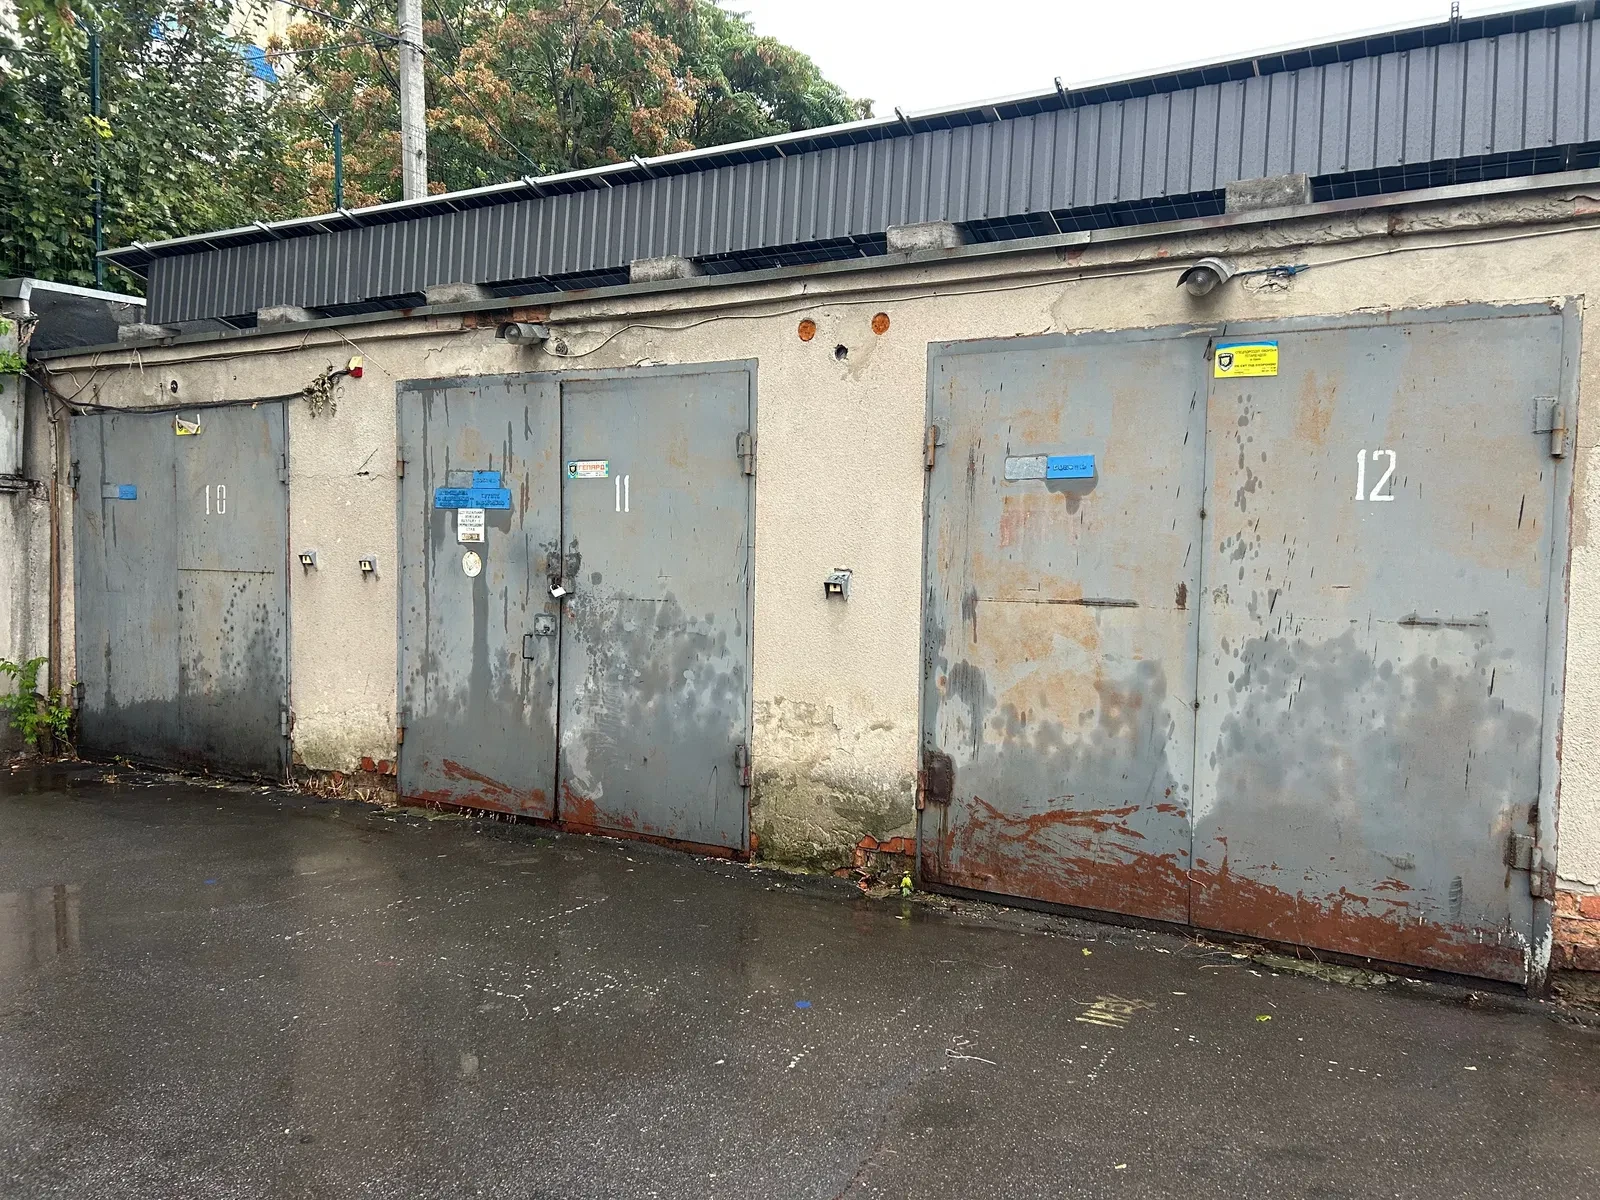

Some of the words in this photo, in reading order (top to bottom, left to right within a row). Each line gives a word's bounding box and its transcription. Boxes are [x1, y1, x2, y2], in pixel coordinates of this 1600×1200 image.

[615, 474, 630, 512] 11
[1355, 449, 1396, 501] 12
[206, 484, 226, 514] 10
